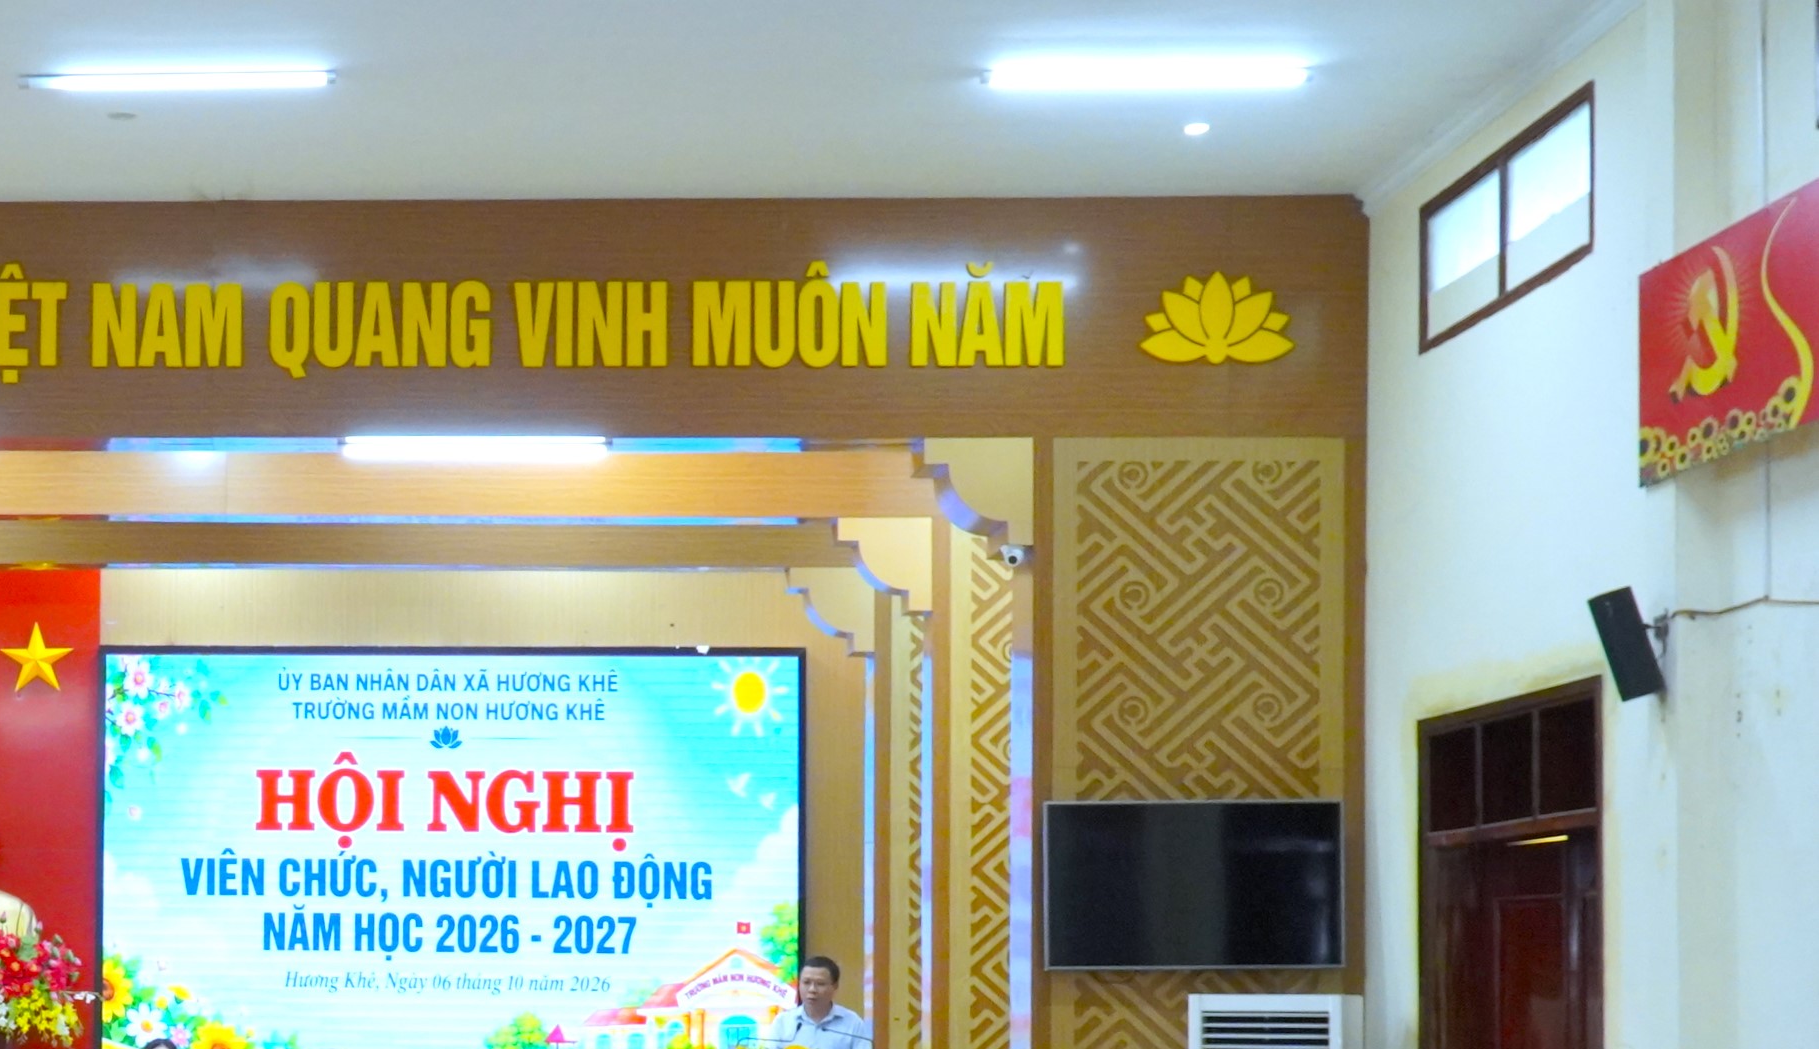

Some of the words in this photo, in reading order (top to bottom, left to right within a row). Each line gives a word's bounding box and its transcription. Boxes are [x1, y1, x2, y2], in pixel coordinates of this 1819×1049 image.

[90, 282, 243, 368] NAM
[268, 280, 492, 378] QUANG
[513, 281, 670, 368] VINH
[692, 260, 887, 368] MUÔN
[909, 261, 1066, 368] NĂM
[278, 667, 303, 692] ỦY
[309, 673, 349, 692] BAN
[356, 668, 409, 692] NHÂN
[417, 668, 456, 692] DÂN
[463, 669, 490, 692] XÃ
[497, 672, 571, 693] HƯƠNG
[578, 669, 619, 693] KHÊ
[292, 697, 375, 720] TRƯỜNG
[382, 695, 429, 720] MẦM
[436, 702, 478, 720] NON
[486, 701, 559, 721] HƯƠNG
[566, 698, 605, 721] KHÊ
[255, 752, 405, 850] HỘI
[427, 770, 634, 852] NGHỊ
[181, 848, 265, 897] VIÊN
[279, 850, 388, 903] CHỨC,
[403, 851, 518, 898] NGƯỜI
[531, 861, 599, 900] LAO
[612, 853, 713, 908] ĐỘNG
[263, 904, 342, 952] NĂM
[354, 913, 424, 961] HỌC
[436, 914, 520, 954] 2026
[553, 916, 637, 955] 2027
[285, 971, 339, 993] Hương
[432, 974, 451, 990] 06
[508, 975, 524, 991] 10
[570, 976, 611, 992] 2026
